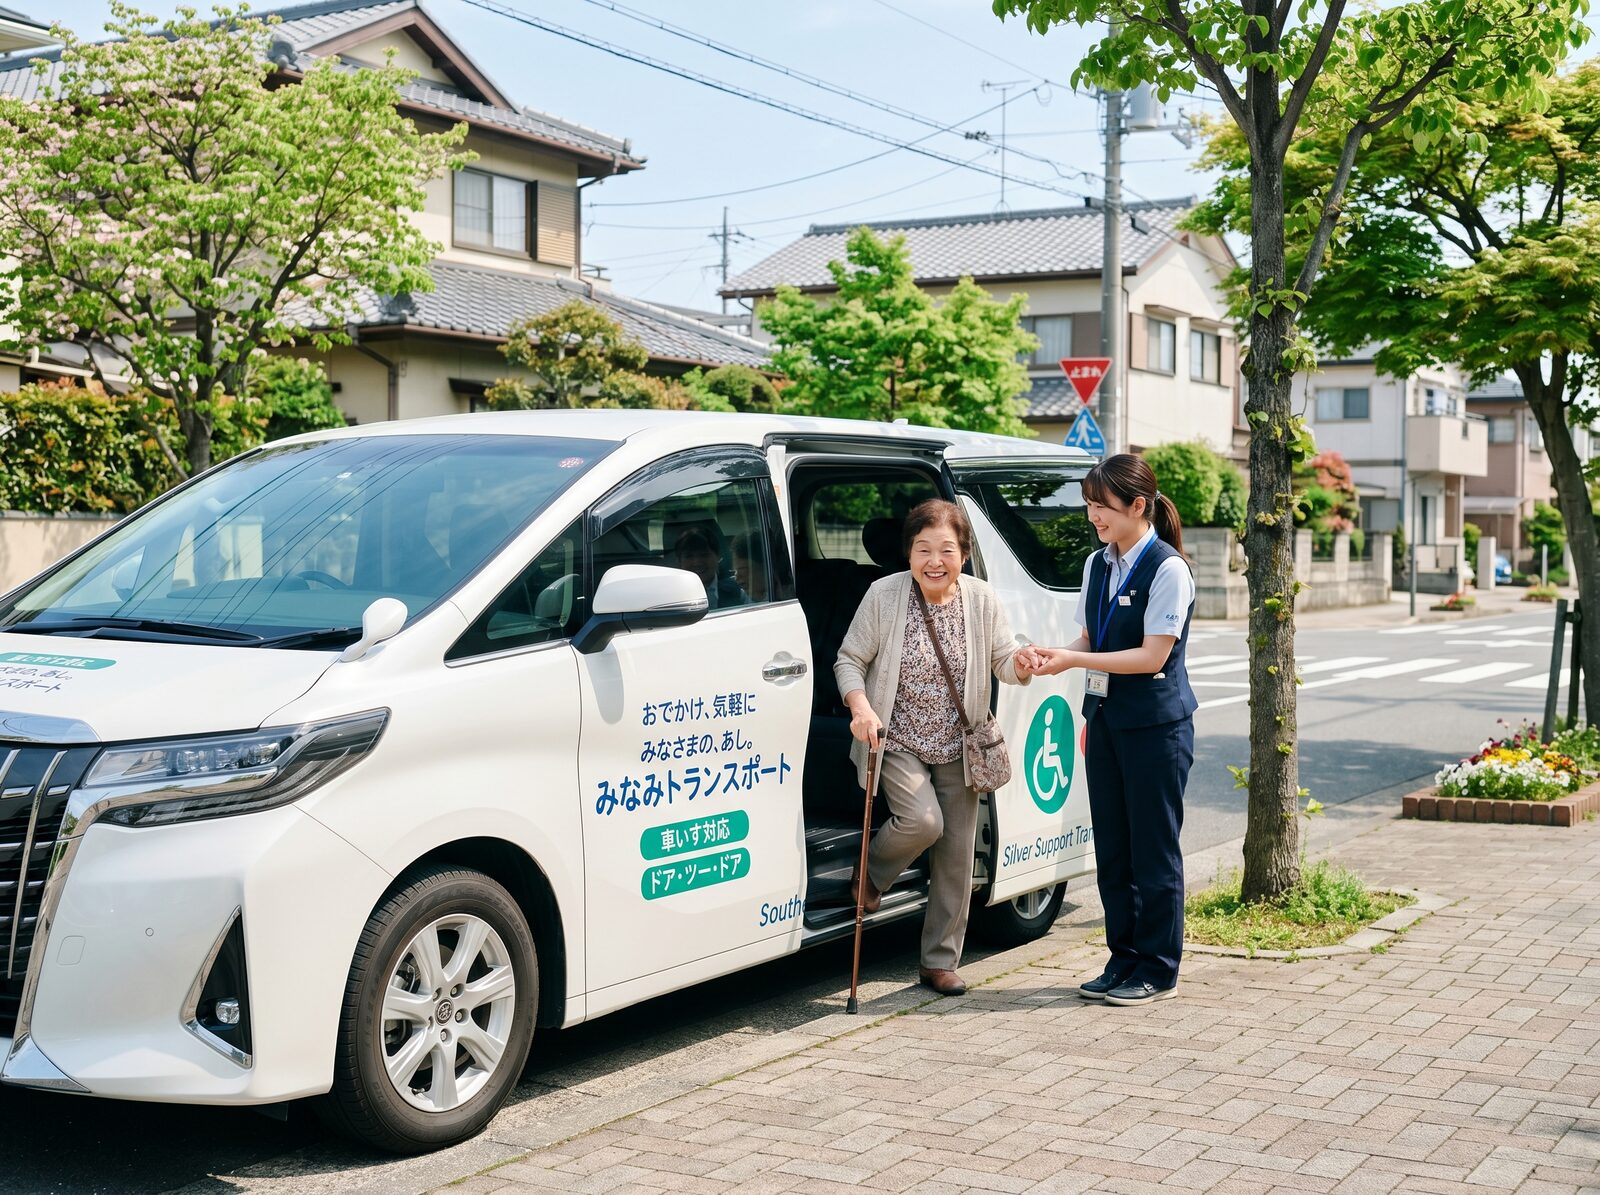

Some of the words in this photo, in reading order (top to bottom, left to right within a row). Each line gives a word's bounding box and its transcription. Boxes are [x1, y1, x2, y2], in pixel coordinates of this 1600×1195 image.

[1070, 366, 1102, 378] 止まれ
[642, 692, 757, 726] おでかけ、気軽に
[640, 729, 754, 763] みなさまの、あし。
[595, 753, 793, 816] みなみトランスポート
[660, 817, 731, 852] 車いす対応
[1002, 841, 1033, 868] Silver
[1034, 828, 1074, 859] Support
[650, 853, 743, 895] ドア・ツー・ドア
